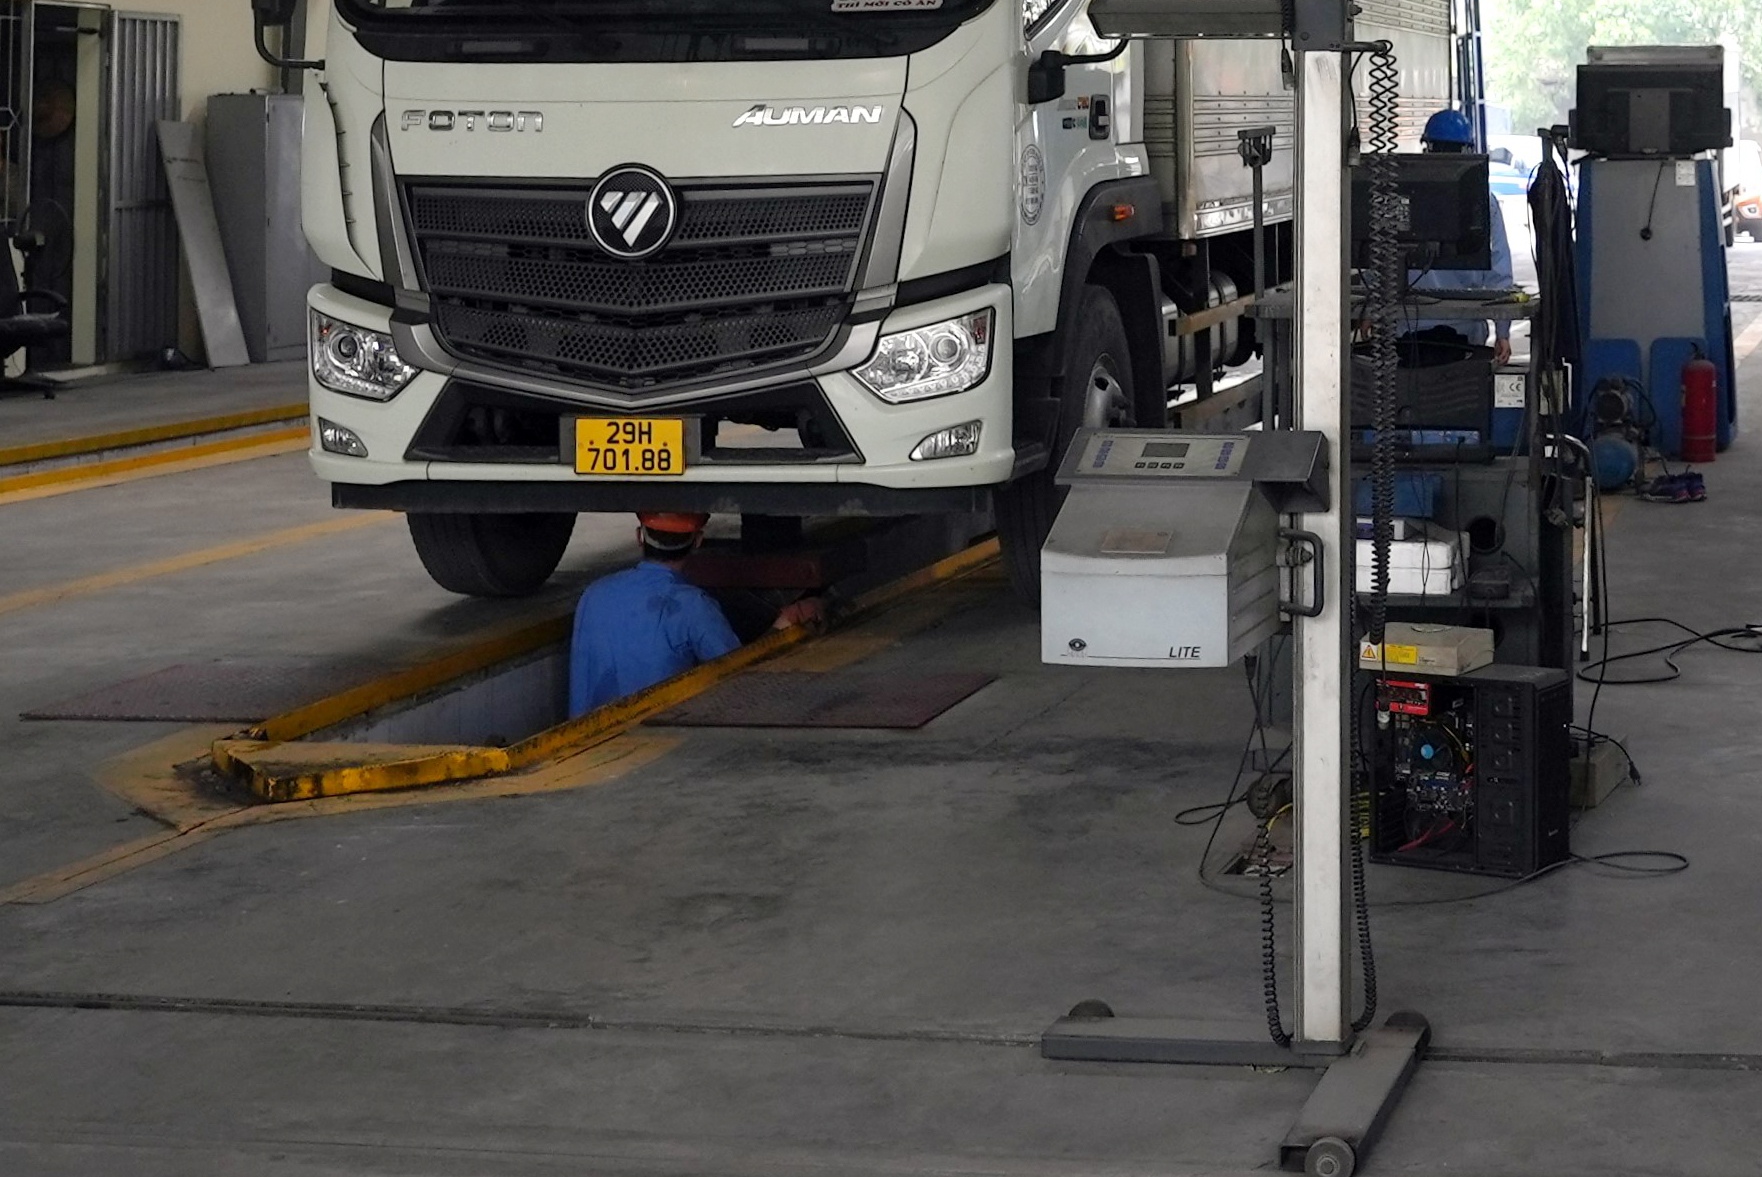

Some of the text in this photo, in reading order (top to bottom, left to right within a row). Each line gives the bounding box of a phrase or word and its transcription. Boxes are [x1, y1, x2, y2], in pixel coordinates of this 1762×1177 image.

[401, 110, 544, 133] FOTON
[732, 104, 883, 128] AUMAN
[606, 421, 652, 444] 29H
[587, 447, 671, 472] 701.88
[1169, 646, 1201, 659] LITE
